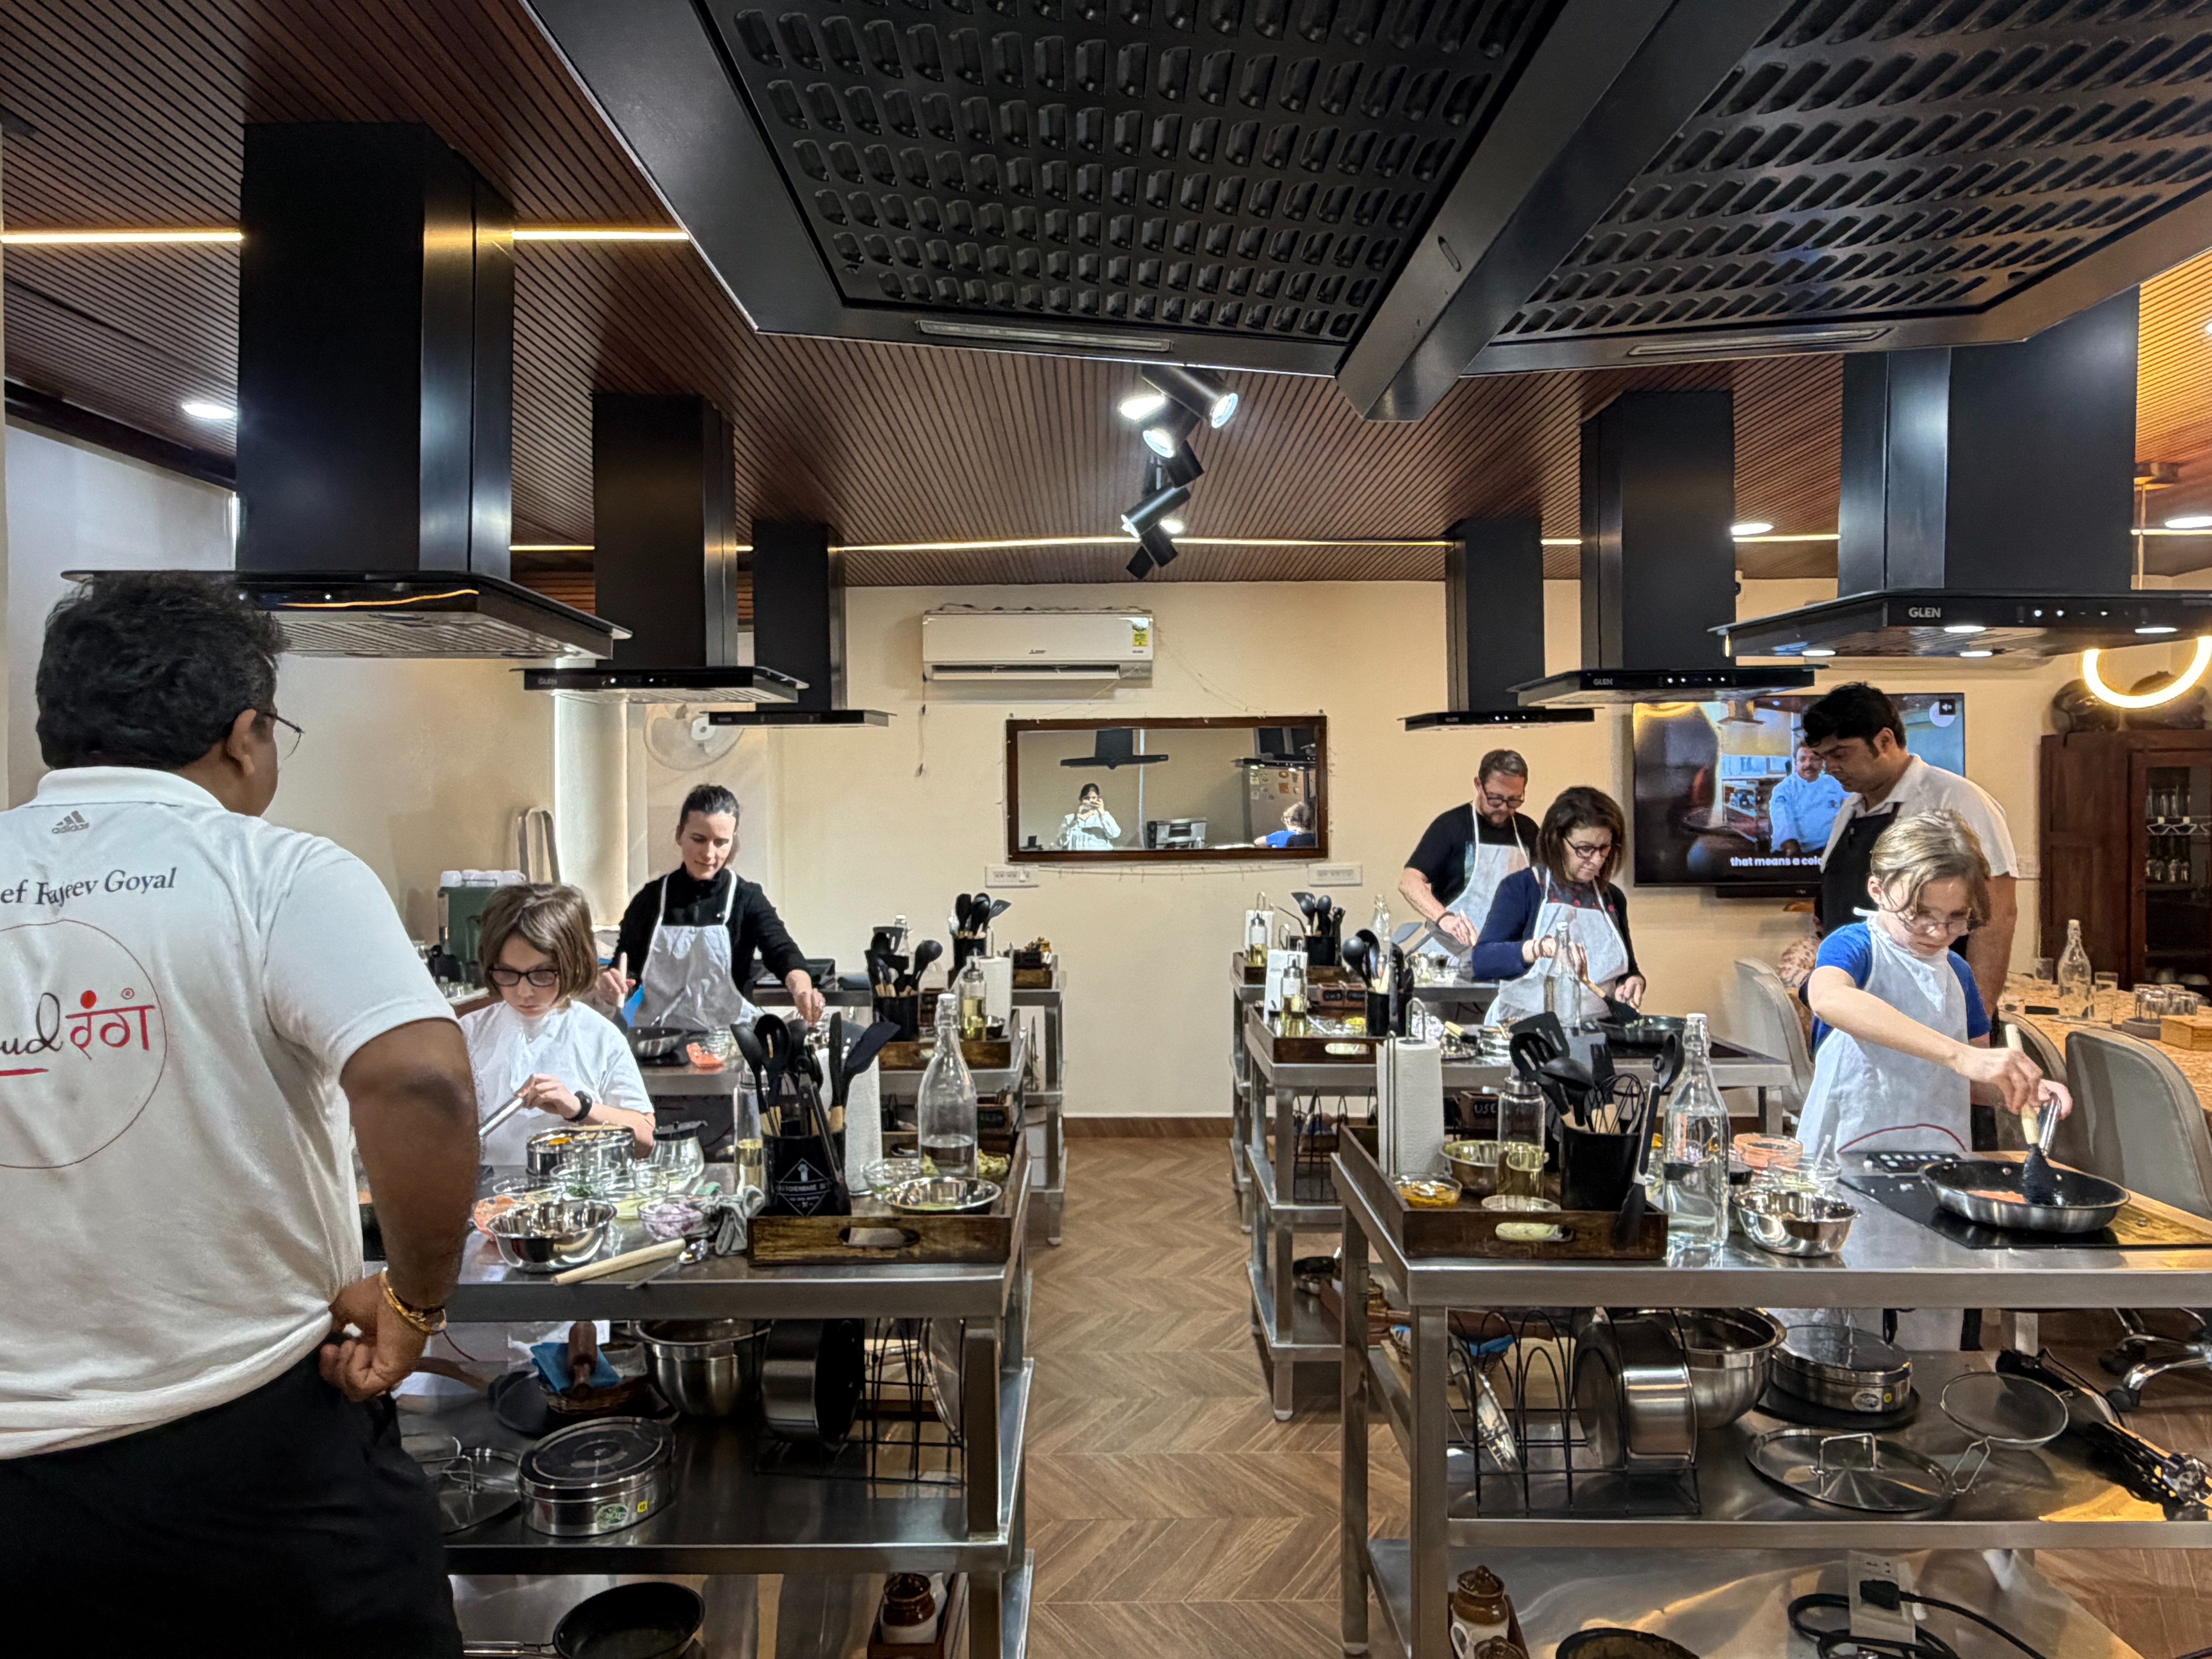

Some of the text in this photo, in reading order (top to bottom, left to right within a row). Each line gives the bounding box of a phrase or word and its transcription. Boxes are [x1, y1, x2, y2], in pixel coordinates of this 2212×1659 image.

[1908, 607, 1941, 618] GLEN
[1730, 857, 1753, 866] that
[1754, 857, 1791, 866] means
[104, 867, 177, 894] Goyal
